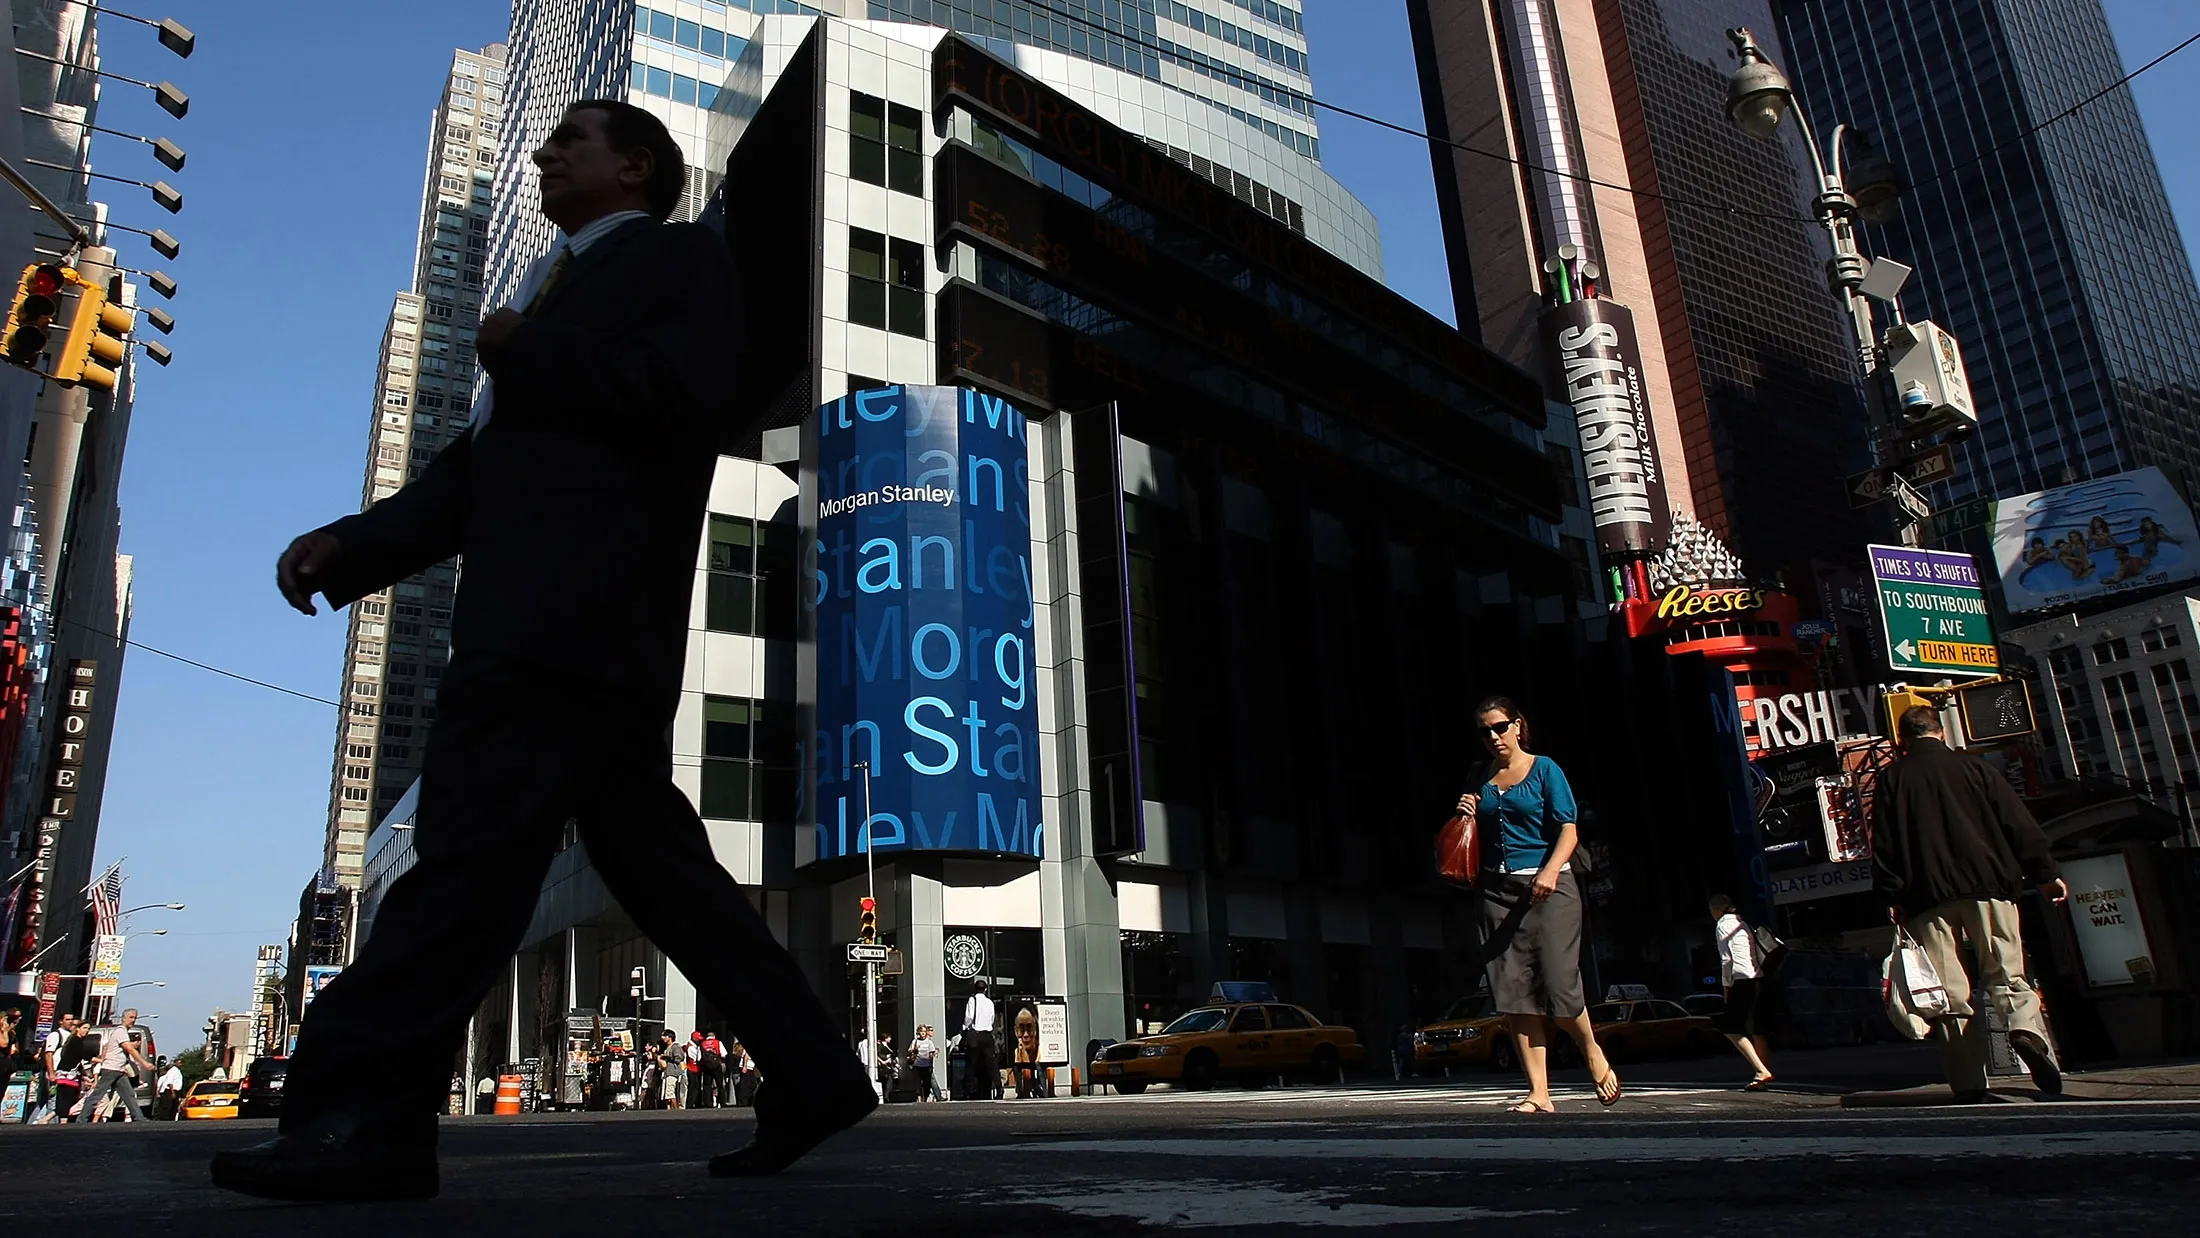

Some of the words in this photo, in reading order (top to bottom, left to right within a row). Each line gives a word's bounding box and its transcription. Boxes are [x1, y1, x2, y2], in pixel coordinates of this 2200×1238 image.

[1626, 365, 1650, 443] Chocolate
[1559, 321, 1652, 528] HERSHEY'S
[1639, 444, 1658, 484] Milk
[819, 490, 879, 519] Morgan
[881, 483, 955, 506] Stanley
[1936, 514, 1948, 534] W
[1954, 507, 1969, 528] 47
[1876, 557, 1911, 576] TIMES
[1914, 561, 1932, 579] SQ
[1657, 584, 1766, 619] Reese's
[1883, 590, 1902, 608] TO
[1921, 617, 1931, 634] 7
[1940, 618, 1965, 637] AVE
[1920, 642, 1956, 661] TURN
[1961, 646, 1997, 664] HERE
[51, 689, 90, 816] HOTEL
[1823, 871, 1844, 888] OR
[2075, 889, 2127, 904] HEAVEN
[2089, 904, 2118, 915] CAN
[258, 945, 283, 960] MTC
[946, 935, 982, 954] STARBUCKS
[950, 964, 978, 976] COFFEE
[256, 1026, 267, 1056] PARK
